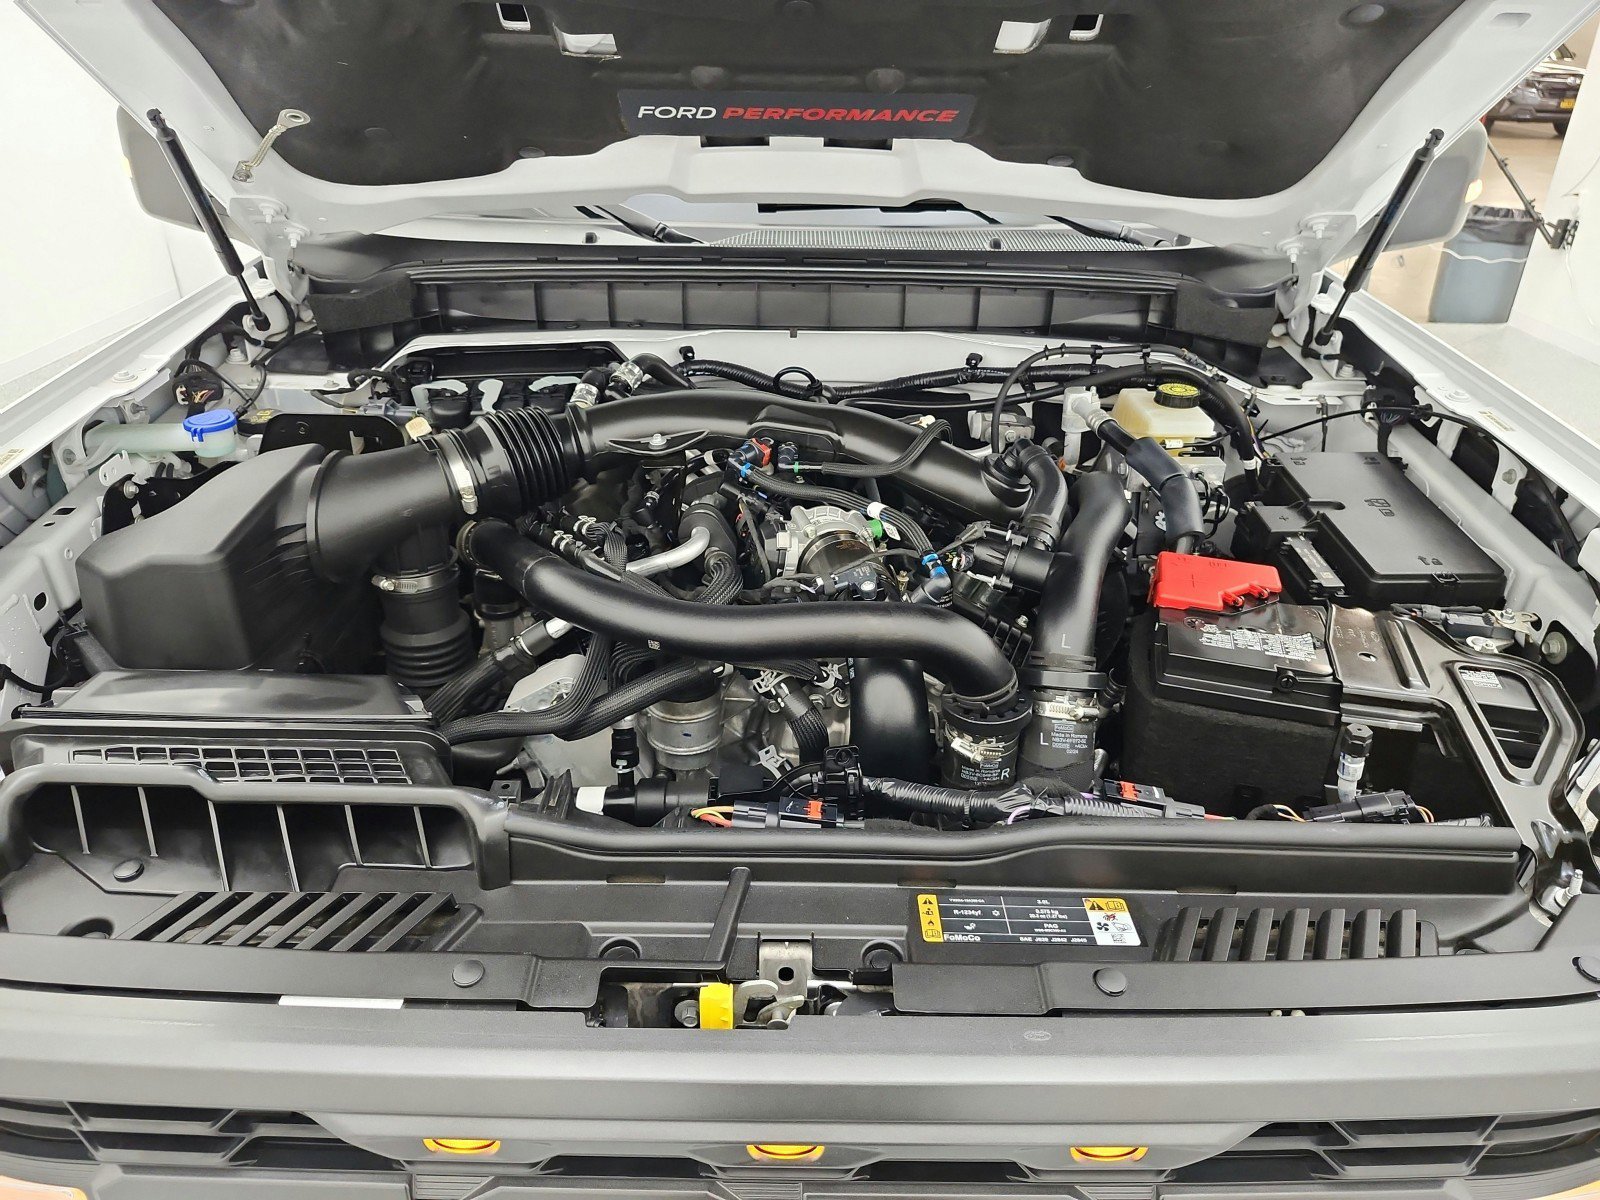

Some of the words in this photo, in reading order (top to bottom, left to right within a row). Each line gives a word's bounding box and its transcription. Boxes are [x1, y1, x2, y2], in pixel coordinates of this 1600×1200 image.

[637, 106, 717, 119] FORD
[722, 107, 959, 122] PERFORMANCE
[1061, 634, 1071, 648] L
[1040, 732, 1049, 746] L
[1000, 768, 1010, 780] R
[953, 909, 982, 917] R-1234yf
[943, 933, 981, 941] FoMoCo
